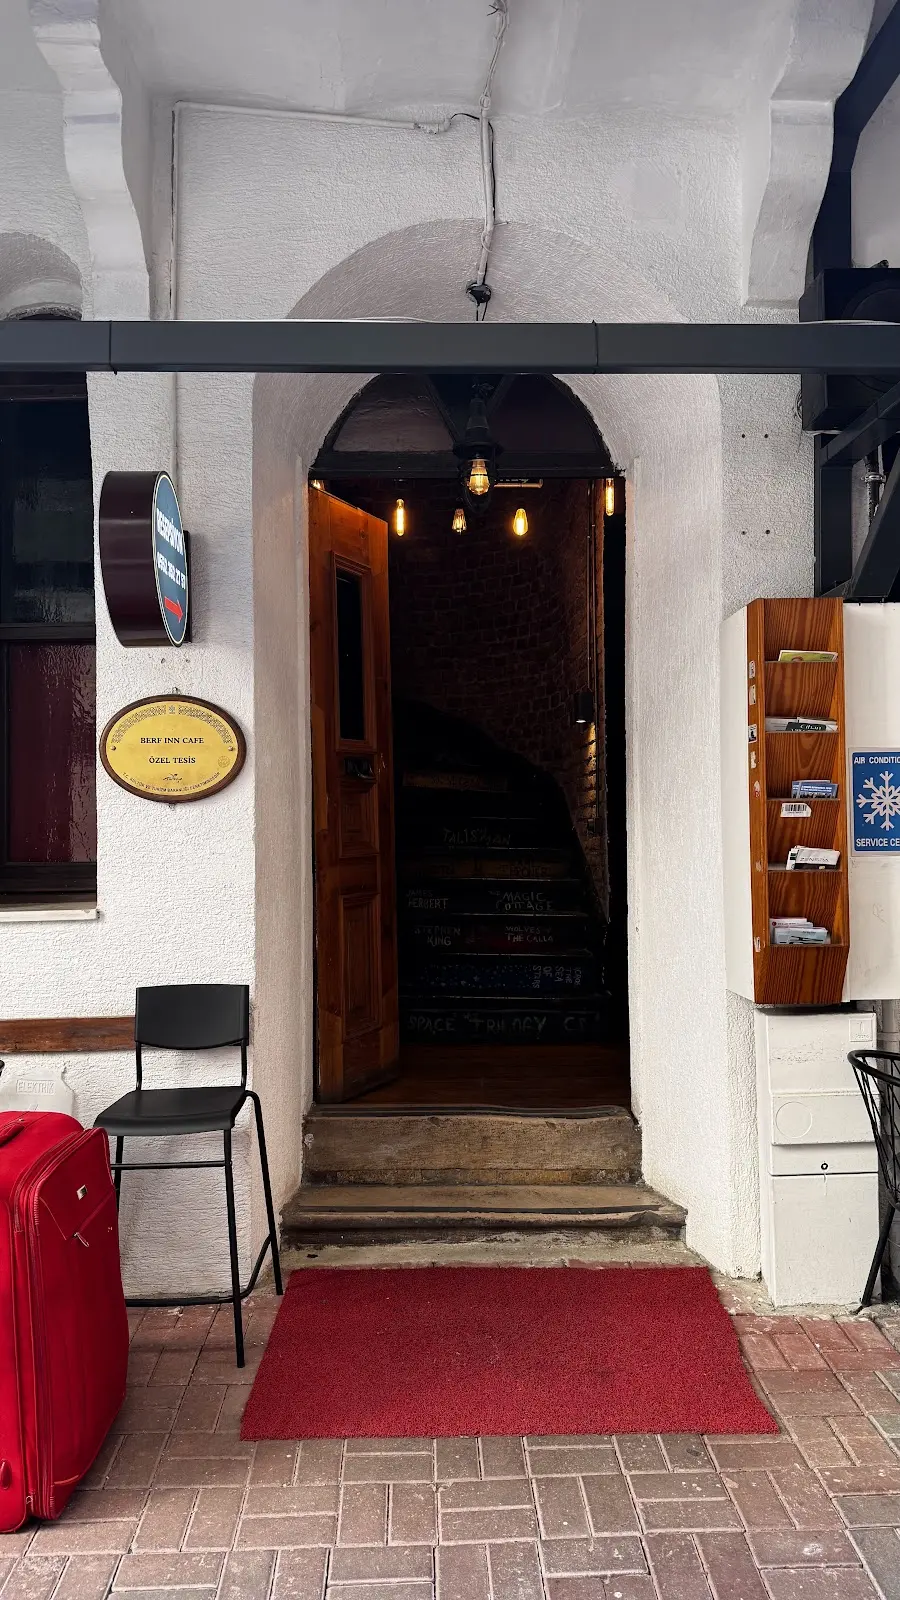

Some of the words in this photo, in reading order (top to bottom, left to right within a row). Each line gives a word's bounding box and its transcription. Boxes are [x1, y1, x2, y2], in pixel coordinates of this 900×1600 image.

[148, 755, 171, 764] ÖZEL
[172, 755, 196, 764] TESİS
[853, 756, 866, 764] AIR
[855, 838, 889, 847] SERVICE
[502, 891, 547, 902] MAGIC
[495, 900, 553, 911] COTTAGE
[427, 935, 452, 947] KING
[505, 933, 525, 943] THE
[408, 1015, 457, 1034] SPACE
